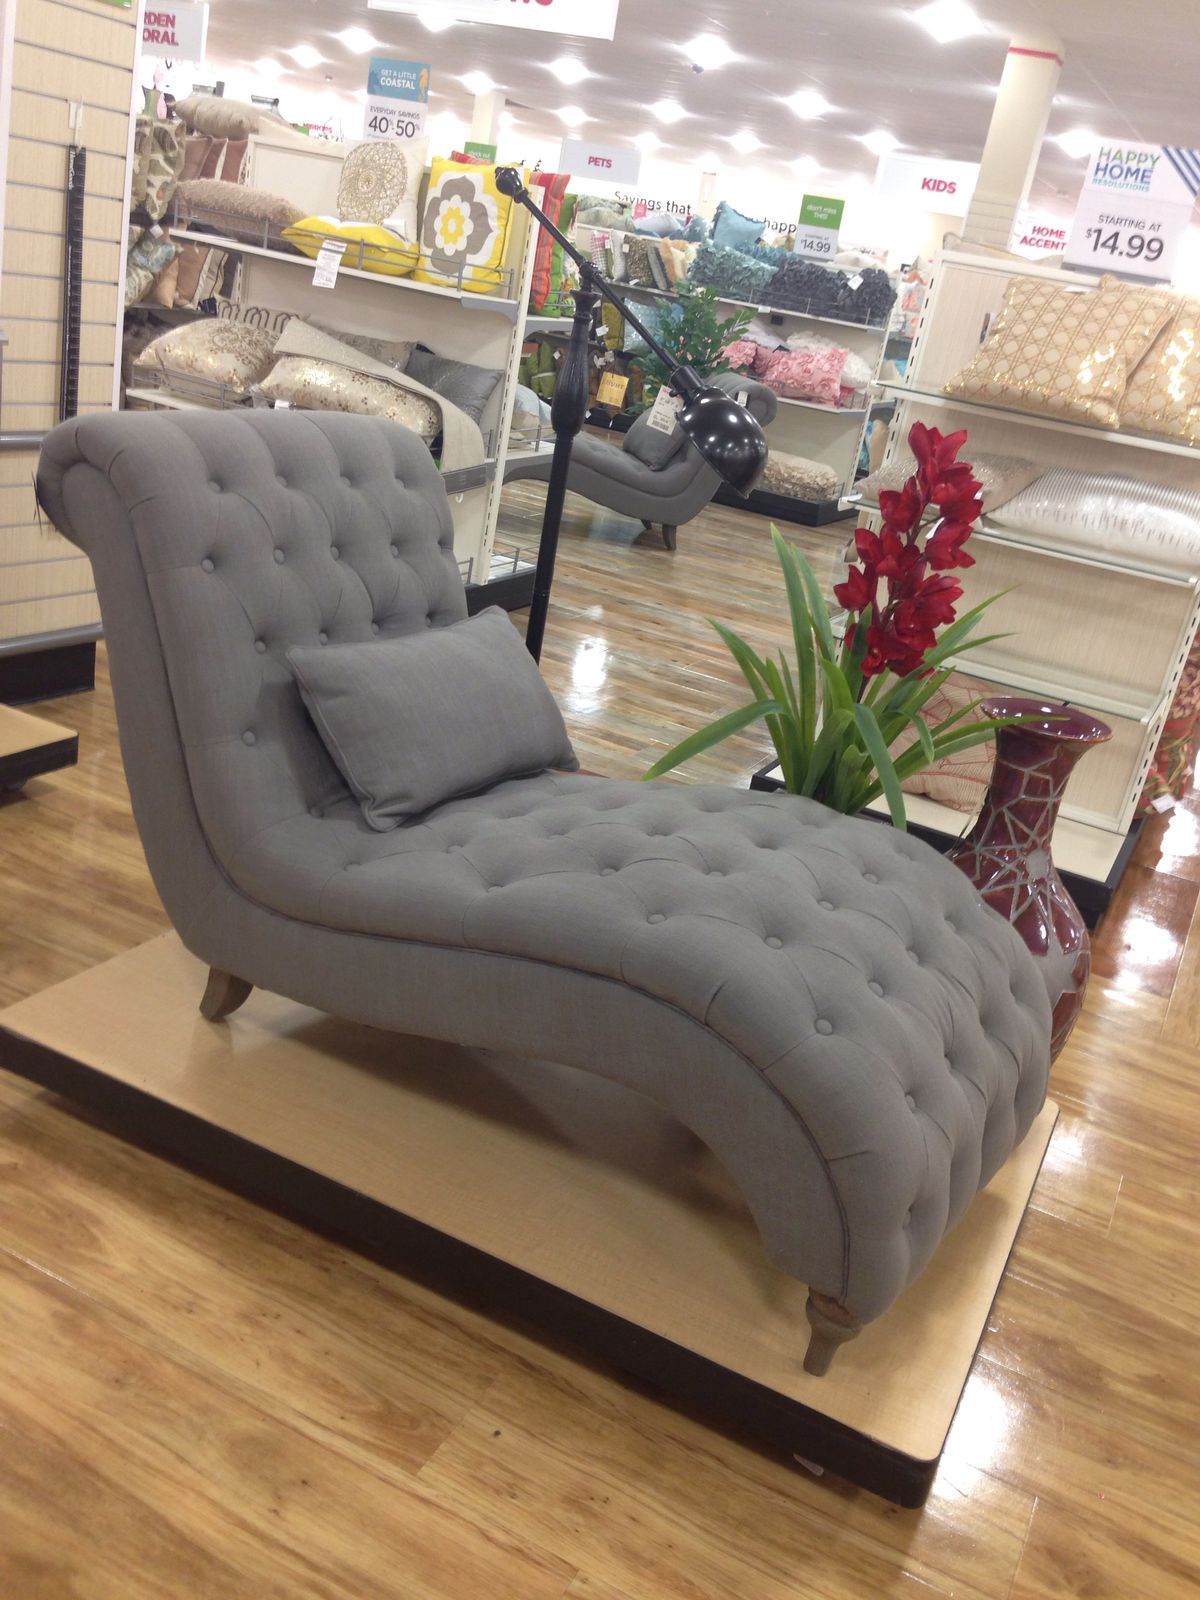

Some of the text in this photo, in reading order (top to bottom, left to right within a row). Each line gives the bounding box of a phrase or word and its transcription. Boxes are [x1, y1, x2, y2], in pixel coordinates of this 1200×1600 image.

[380, 76, 416, 90] COASTAL
[398, 71, 416, 80] LITTLE
[370, 105, 420, 120] EVERYDAY SAVINGS
[588, 156, 612, 169] PETS
[1098, 146, 1162, 170] HAPPY
[1094, 162, 1153, 185] HOME
[921, 177, 956, 195] KIDS
[1092, 178, 1150, 192] RESOLUTIONS
[666, 200, 692, 215] that
[1098, 214, 1163, 233] STARTING AT
[1032, 225, 1066, 240] HOME
[800, 239, 831, 254] $14.99
[1020, 235, 1067, 250] ACCENT
[1085, 228, 1164, 262] $14.99
